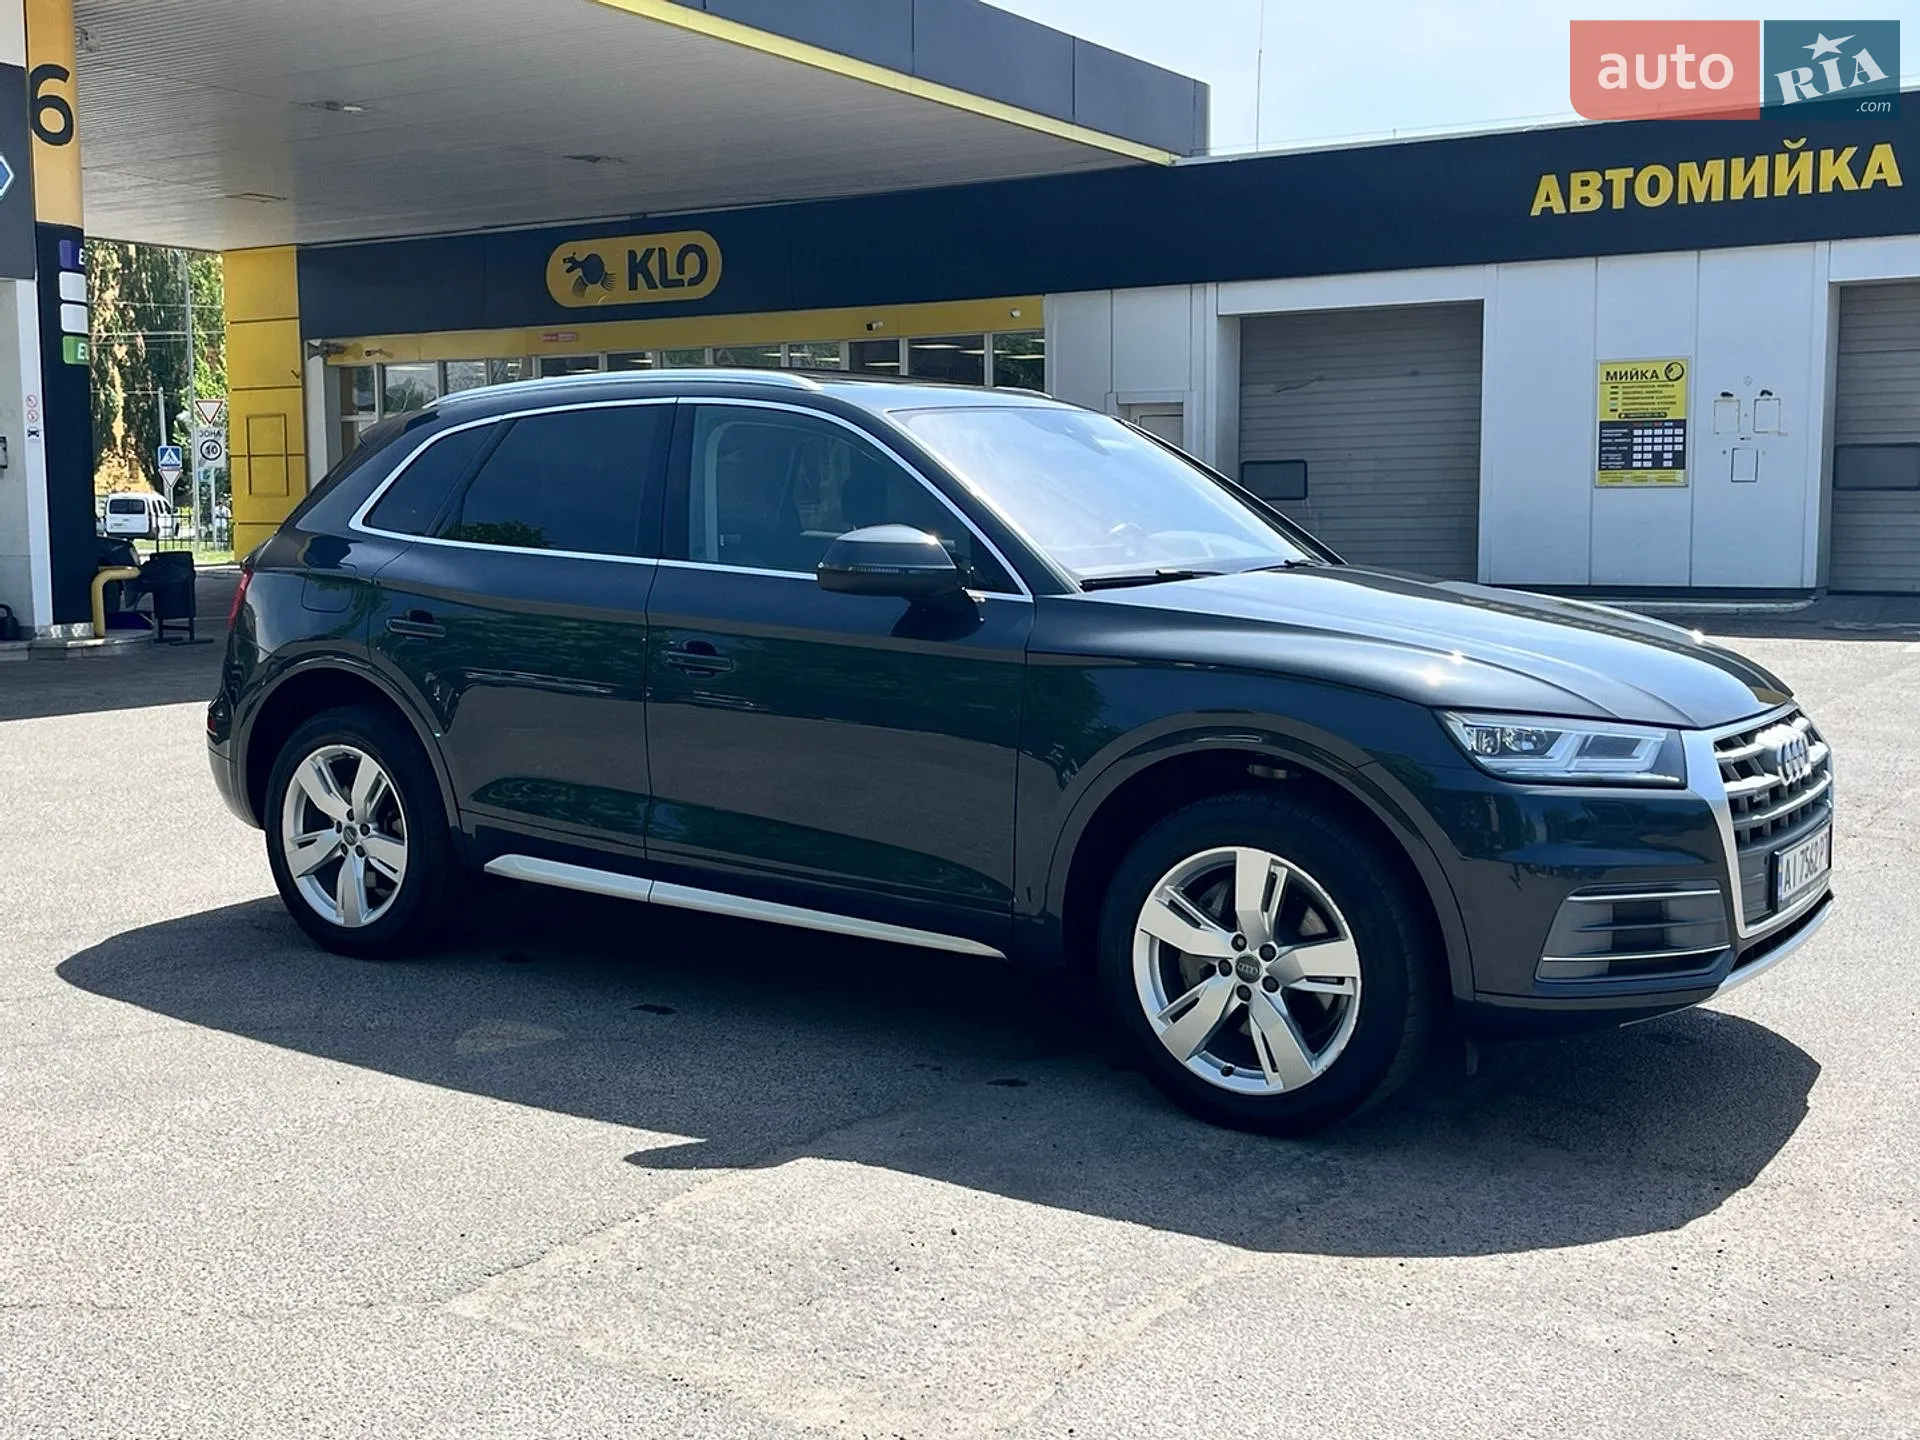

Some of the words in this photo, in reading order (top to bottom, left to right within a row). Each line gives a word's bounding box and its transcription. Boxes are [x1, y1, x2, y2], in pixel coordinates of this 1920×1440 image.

[29, 63, 75, 147] 6
[1529, 136, 1904, 217] АВТОМИЙКА
[626, 242, 709, 292] KLO
[1605, 367, 1660, 381] МИЙКА
